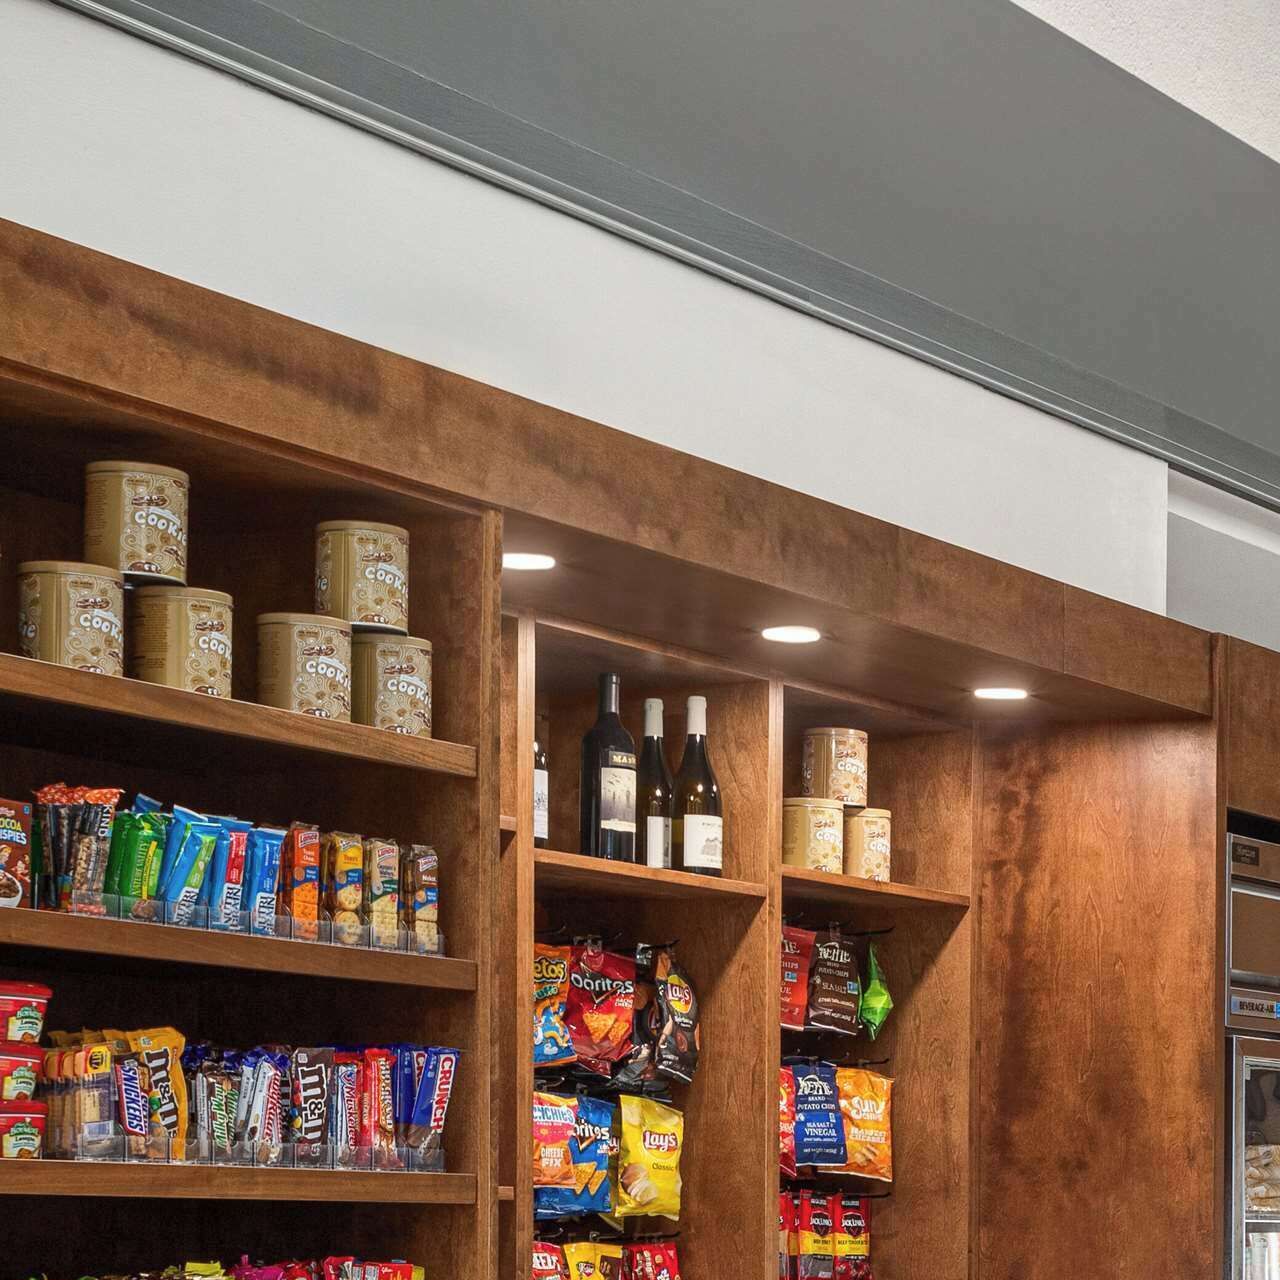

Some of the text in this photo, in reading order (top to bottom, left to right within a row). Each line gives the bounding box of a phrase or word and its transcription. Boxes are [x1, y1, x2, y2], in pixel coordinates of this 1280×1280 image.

[99, 804, 112, 836] KIND
[571, 973, 634, 994] Doritos
[121, 1066, 145, 1132] SNICKERS
[431, 1056, 454, 1130] CRUNCH
[644, 1131, 677, 1151] Lay's
[804, 1128, 837, 1136] VINEGAR
[541, 1147, 564, 1158] CHEESE
[652, 1162, 674, 1171] Classic
